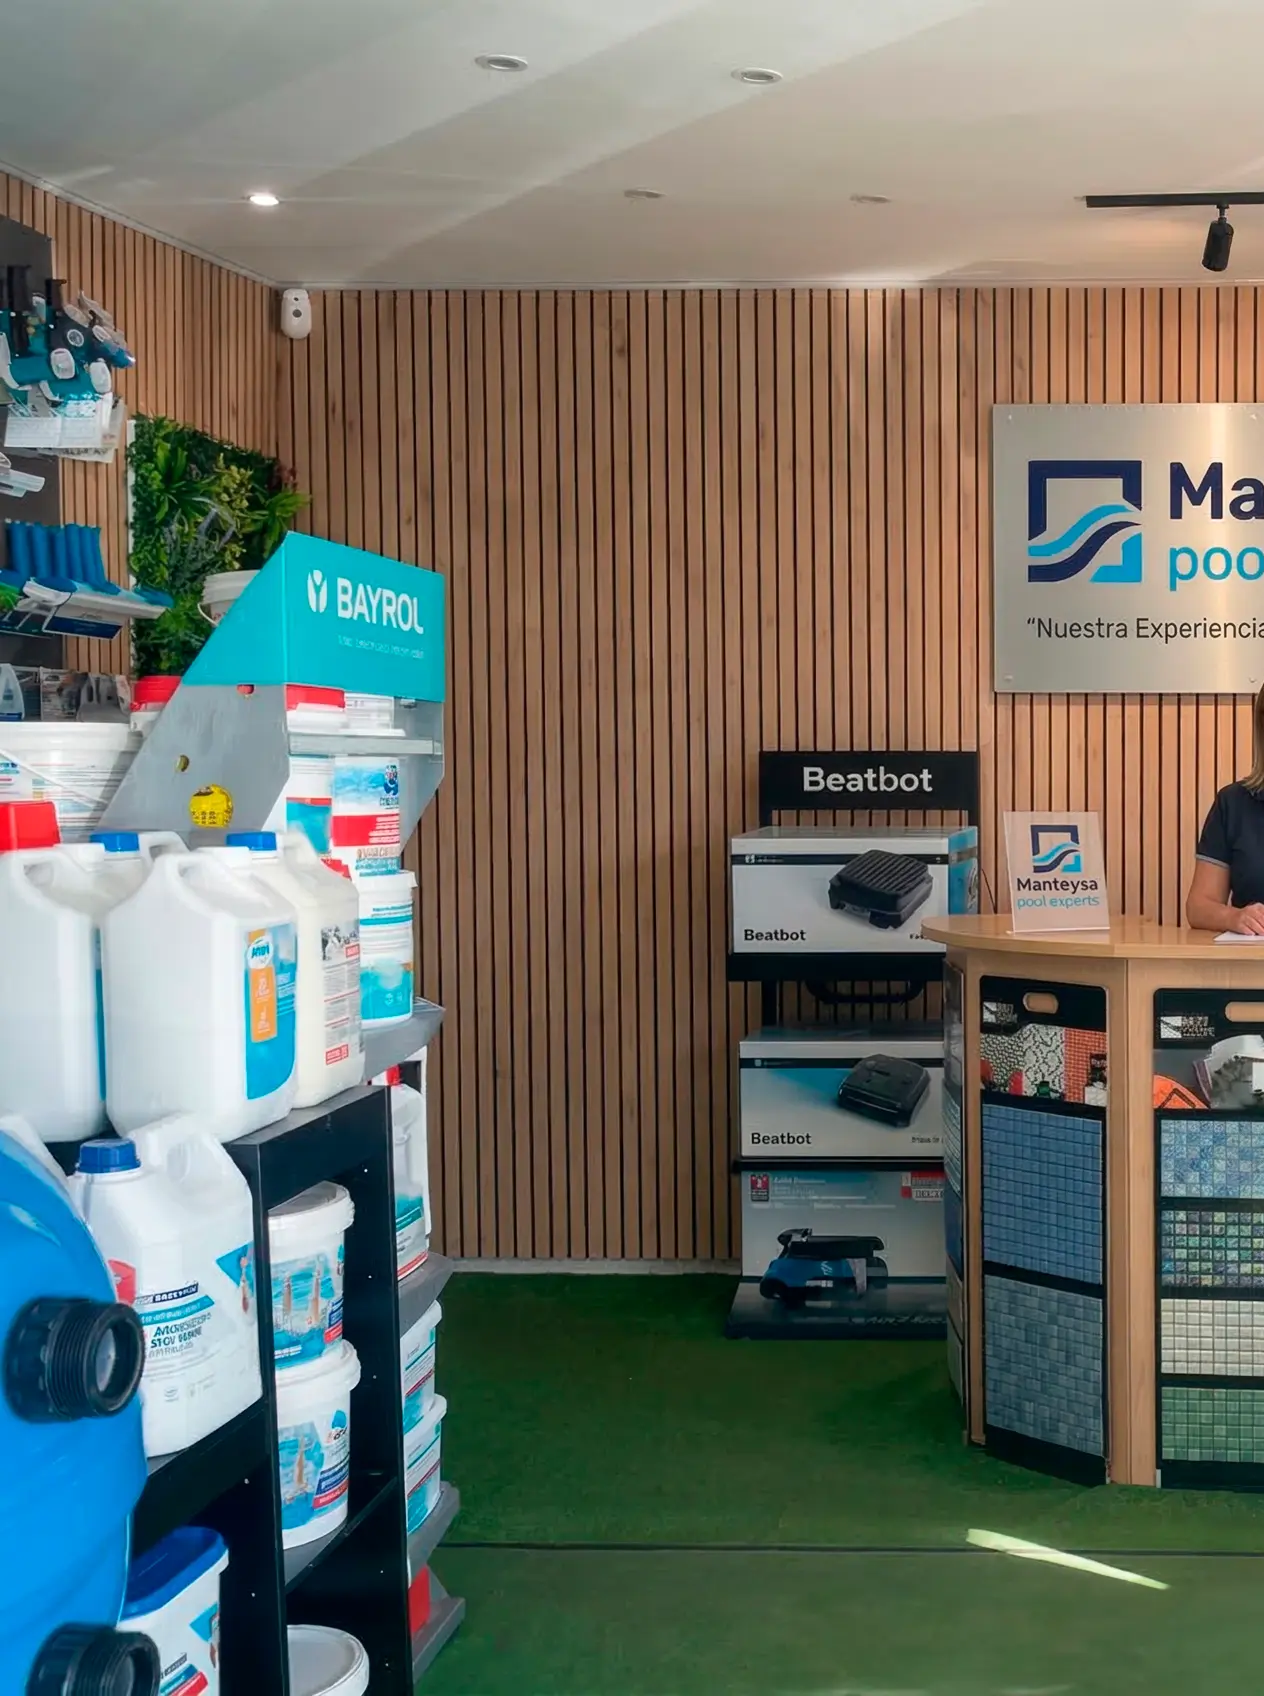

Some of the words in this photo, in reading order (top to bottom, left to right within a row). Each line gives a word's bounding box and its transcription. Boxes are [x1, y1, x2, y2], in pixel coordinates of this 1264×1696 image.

[337, 577, 424, 634] BAYROL
[1026, 616, 1128, 639] “Nuestra
[803, 765, 933, 792] Beatbot
[1016, 877, 1098, 895] Manteysa
[1016, 895, 1047, 911] pool
[1049, 895, 1100, 910] experts
[743, 929, 806, 942] Beatbot
[751, 1132, 812, 1145] Beatbot
